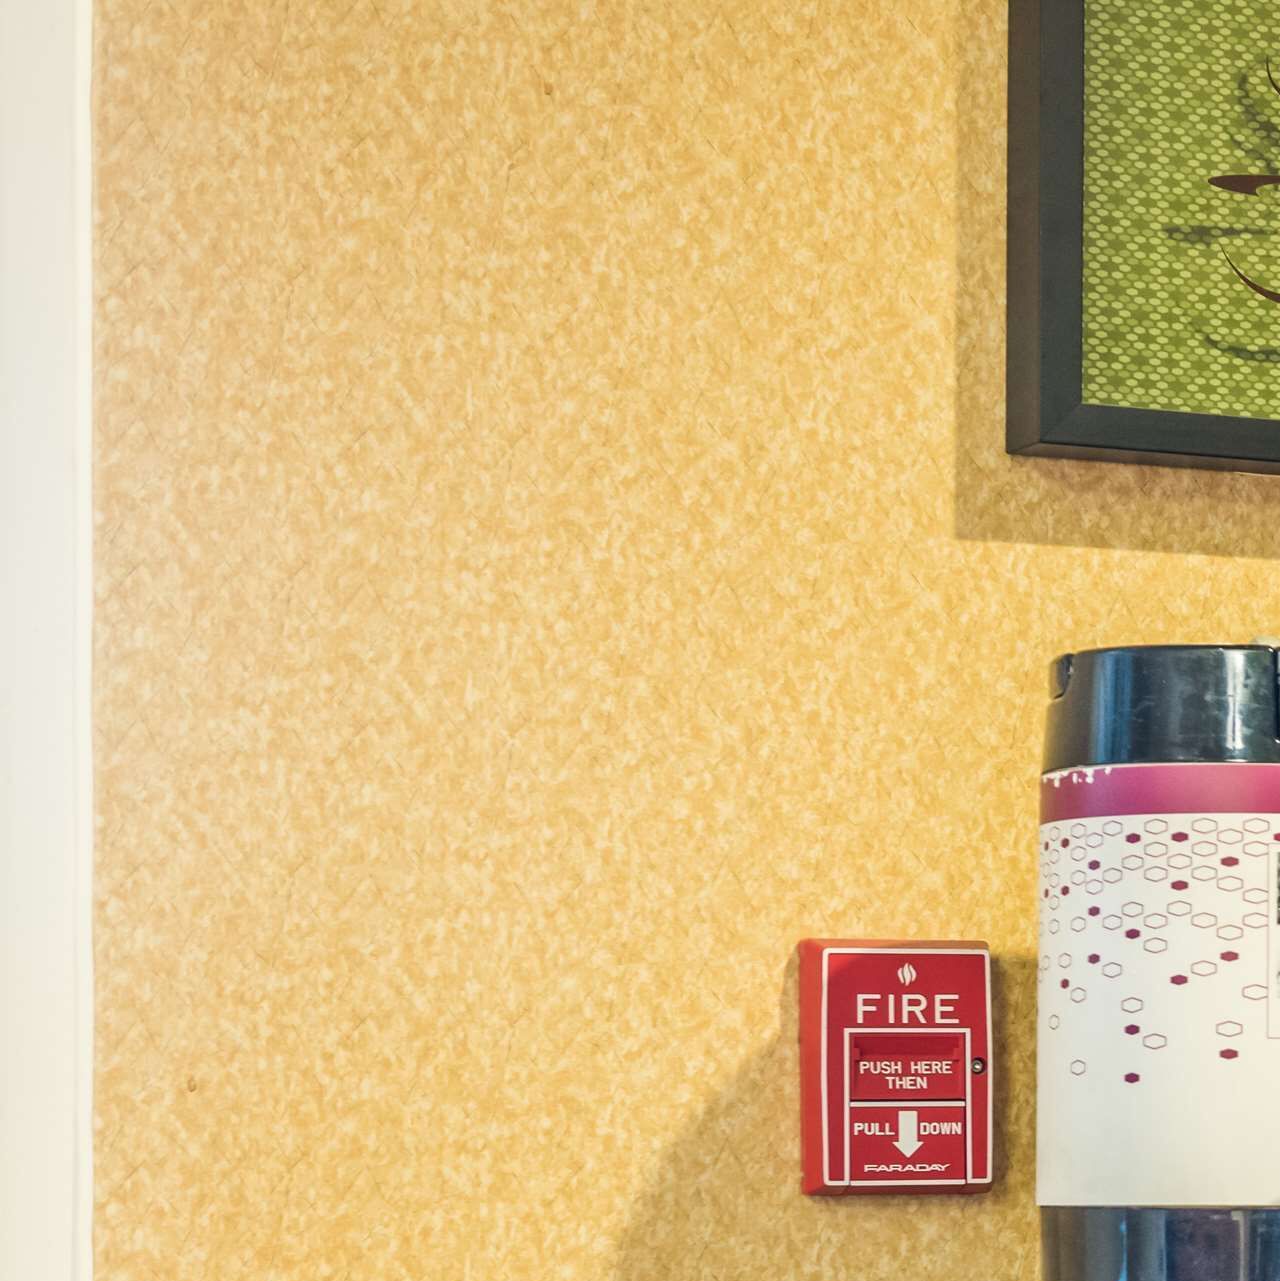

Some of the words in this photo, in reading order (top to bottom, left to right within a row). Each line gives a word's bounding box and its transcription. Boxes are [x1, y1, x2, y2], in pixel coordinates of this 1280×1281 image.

[856, 993, 960, 1024] FIRE
[859, 1061, 902, 1074] PUSH
[911, 1061, 952, 1074] HERE
[886, 1076, 927, 1089] THEN
[853, 1122, 895, 1135] PULL
[919, 1122, 962, 1135] DOWN
[863, 1163, 951, 1173] FARADAY
